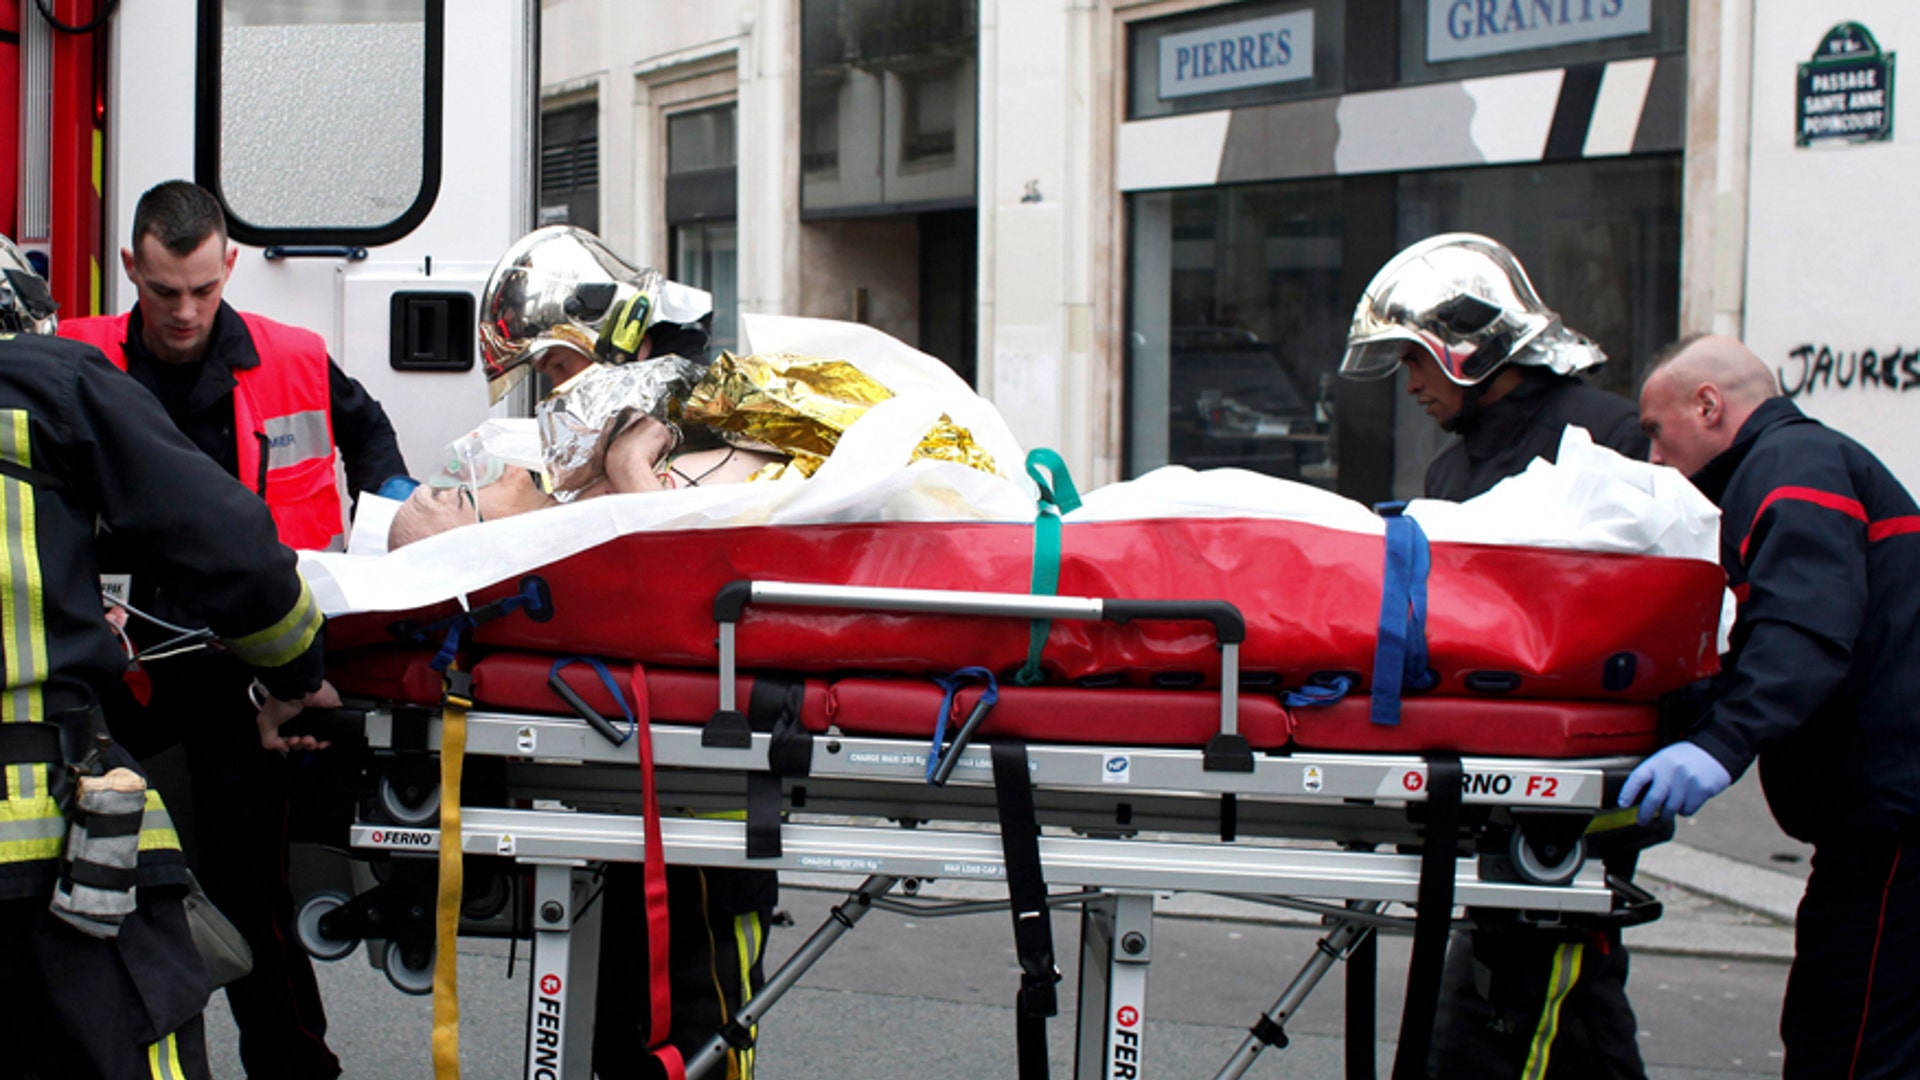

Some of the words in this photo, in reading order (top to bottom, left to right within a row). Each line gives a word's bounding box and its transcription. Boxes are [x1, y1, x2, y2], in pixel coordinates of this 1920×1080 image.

[1176, 28, 1292, 81] PIERRES
[1812, 69, 1876, 92] PASSAGE
[1803, 93, 1847, 114] SAINTE
[1848, 89, 1884, 109] ANNE
[1424, 773, 1512, 795] RNO
[1525, 775, 1558, 798] F2
[382, 831, 432, 846] FERNO
